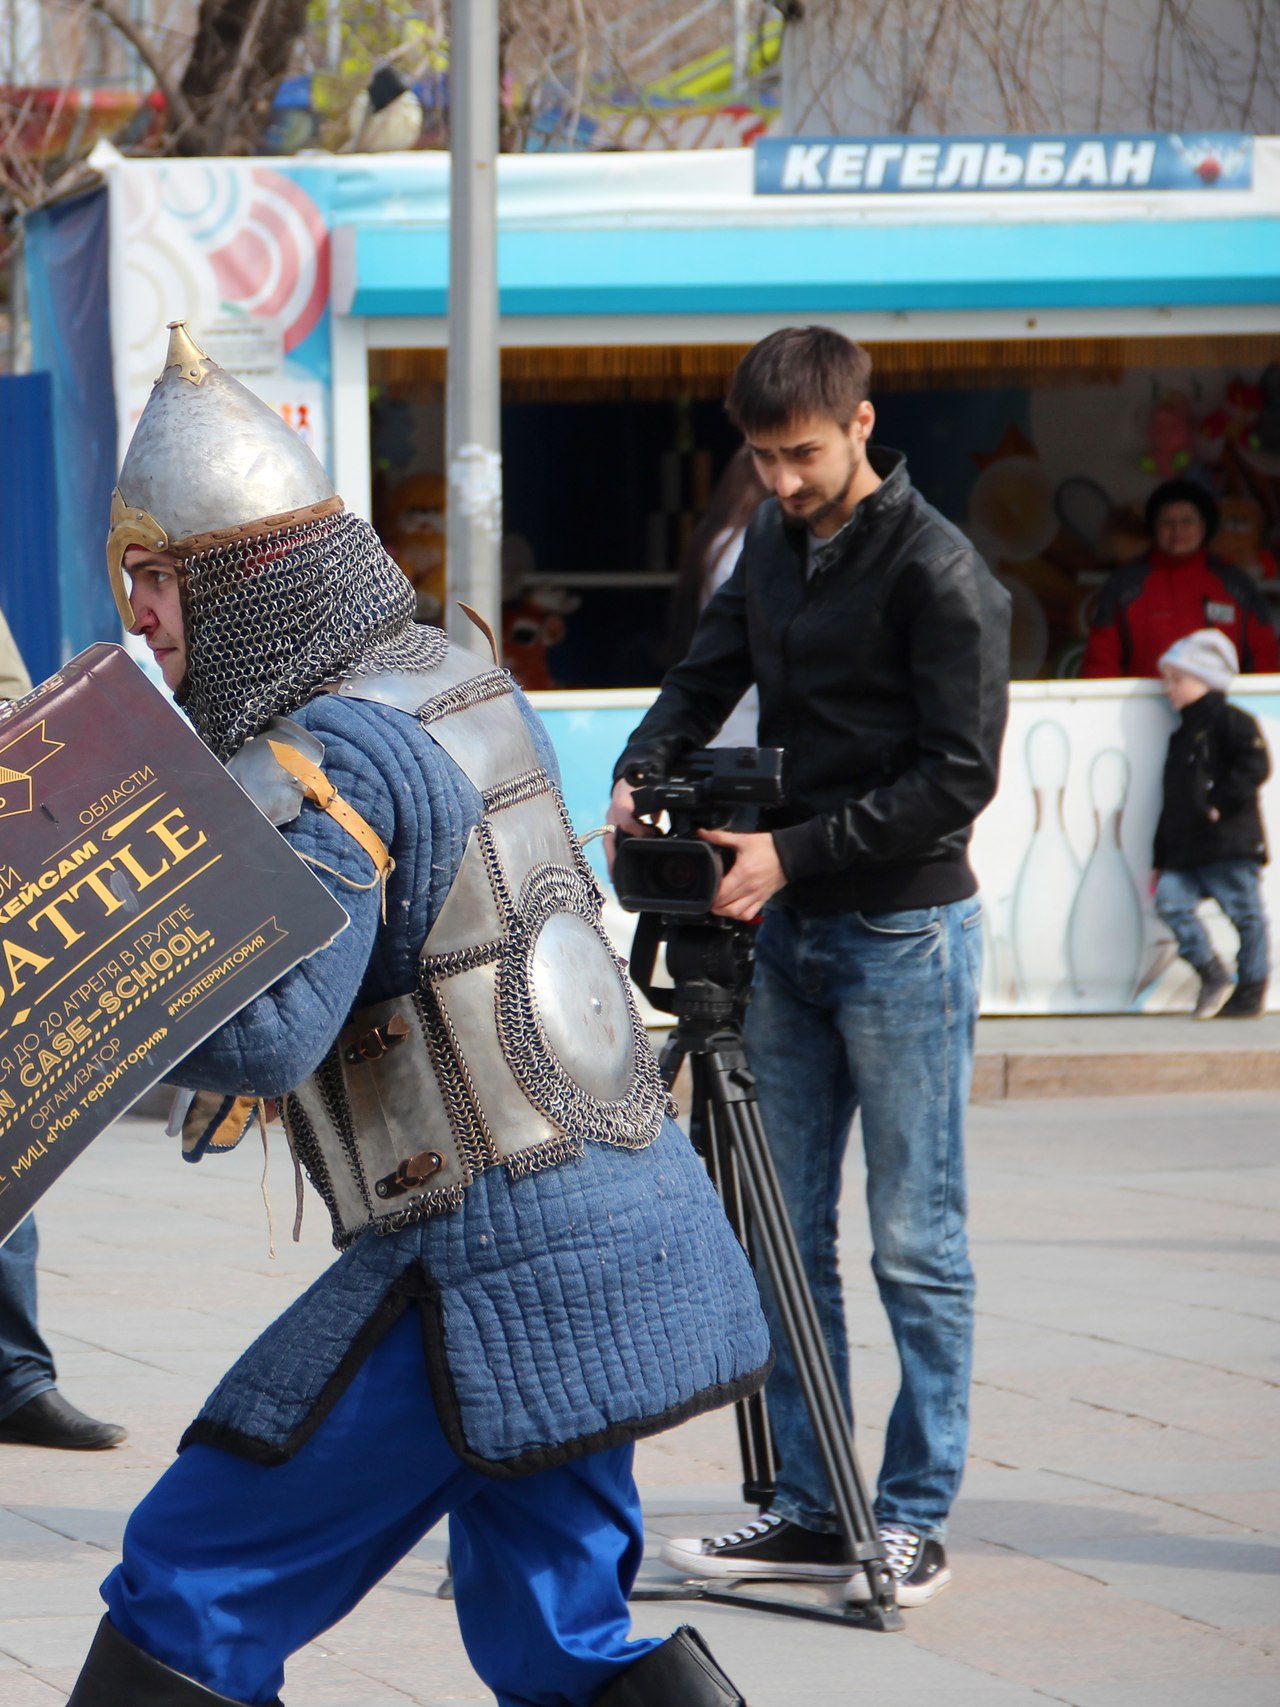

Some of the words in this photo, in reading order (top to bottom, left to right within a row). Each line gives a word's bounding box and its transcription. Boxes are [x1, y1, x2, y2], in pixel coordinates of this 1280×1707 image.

[782, 141, 1156, 188] КЕГЕЛЬБАН
[79, 765, 155, 825] ОБЛАСТИ
[13, 1033, 40, 1065] ДО
[39, 1010, 63, 1037] 20
[63, 960, 123, 1016] АПРЕЛЯ
[119, 950, 136, 967] В
[133, 903, 194, 955] ГРУППЕ
[20, 925, 211, 1087] CASE-SCHOOL
[168, 934, 266, 1017] #МОЯТЕРРИТОРИЯ
[11, 1139, 48, 1178] МИЦ
[46, 1107, 80, 1144] «Моя
[80, 1026, 168, 1108] территория»
[30, 1037, 120, 1130] ОРГАНИЗАТОР
